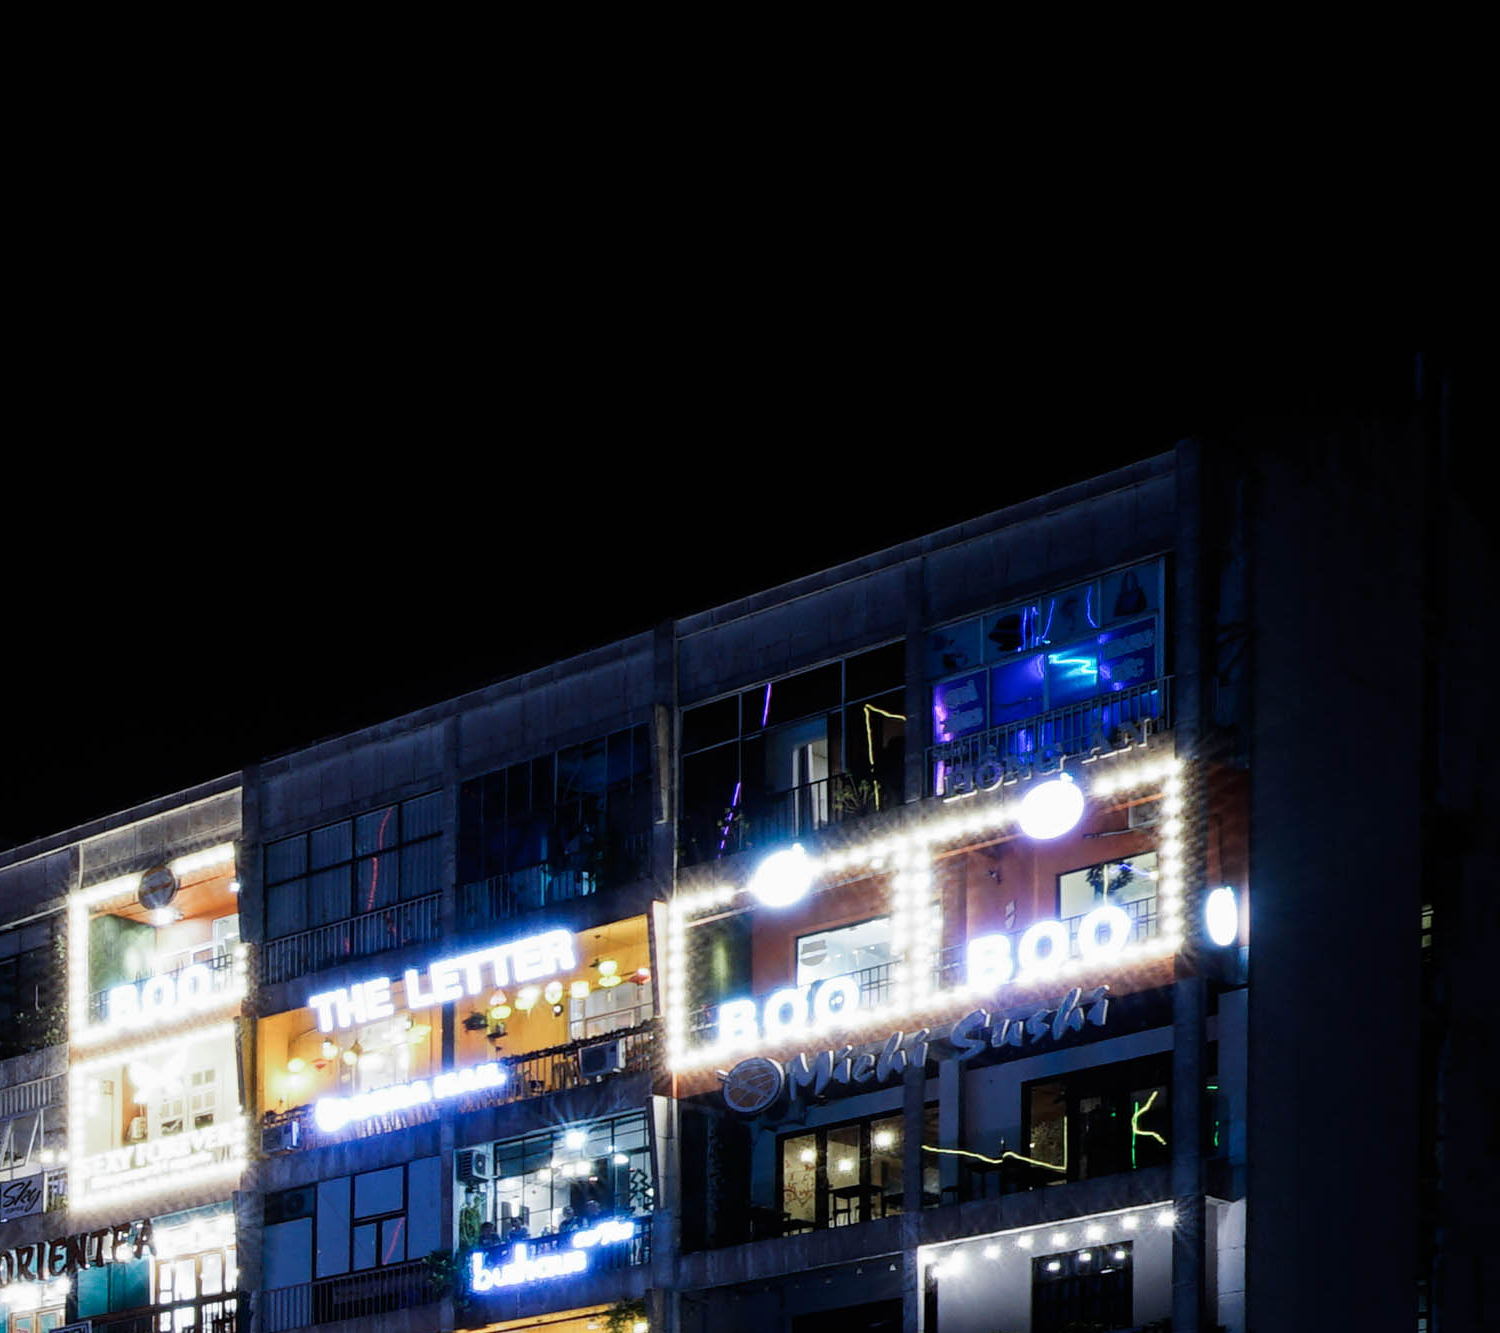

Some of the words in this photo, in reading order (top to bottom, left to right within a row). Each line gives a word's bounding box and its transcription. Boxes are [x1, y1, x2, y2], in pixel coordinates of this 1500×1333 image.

[309, 977, 394, 1033] THE
[404, 929, 576, 1010] LETTER
[950, 984, 1110, 1061] Sushi
[3, 1174, 42, 1212] Sky
